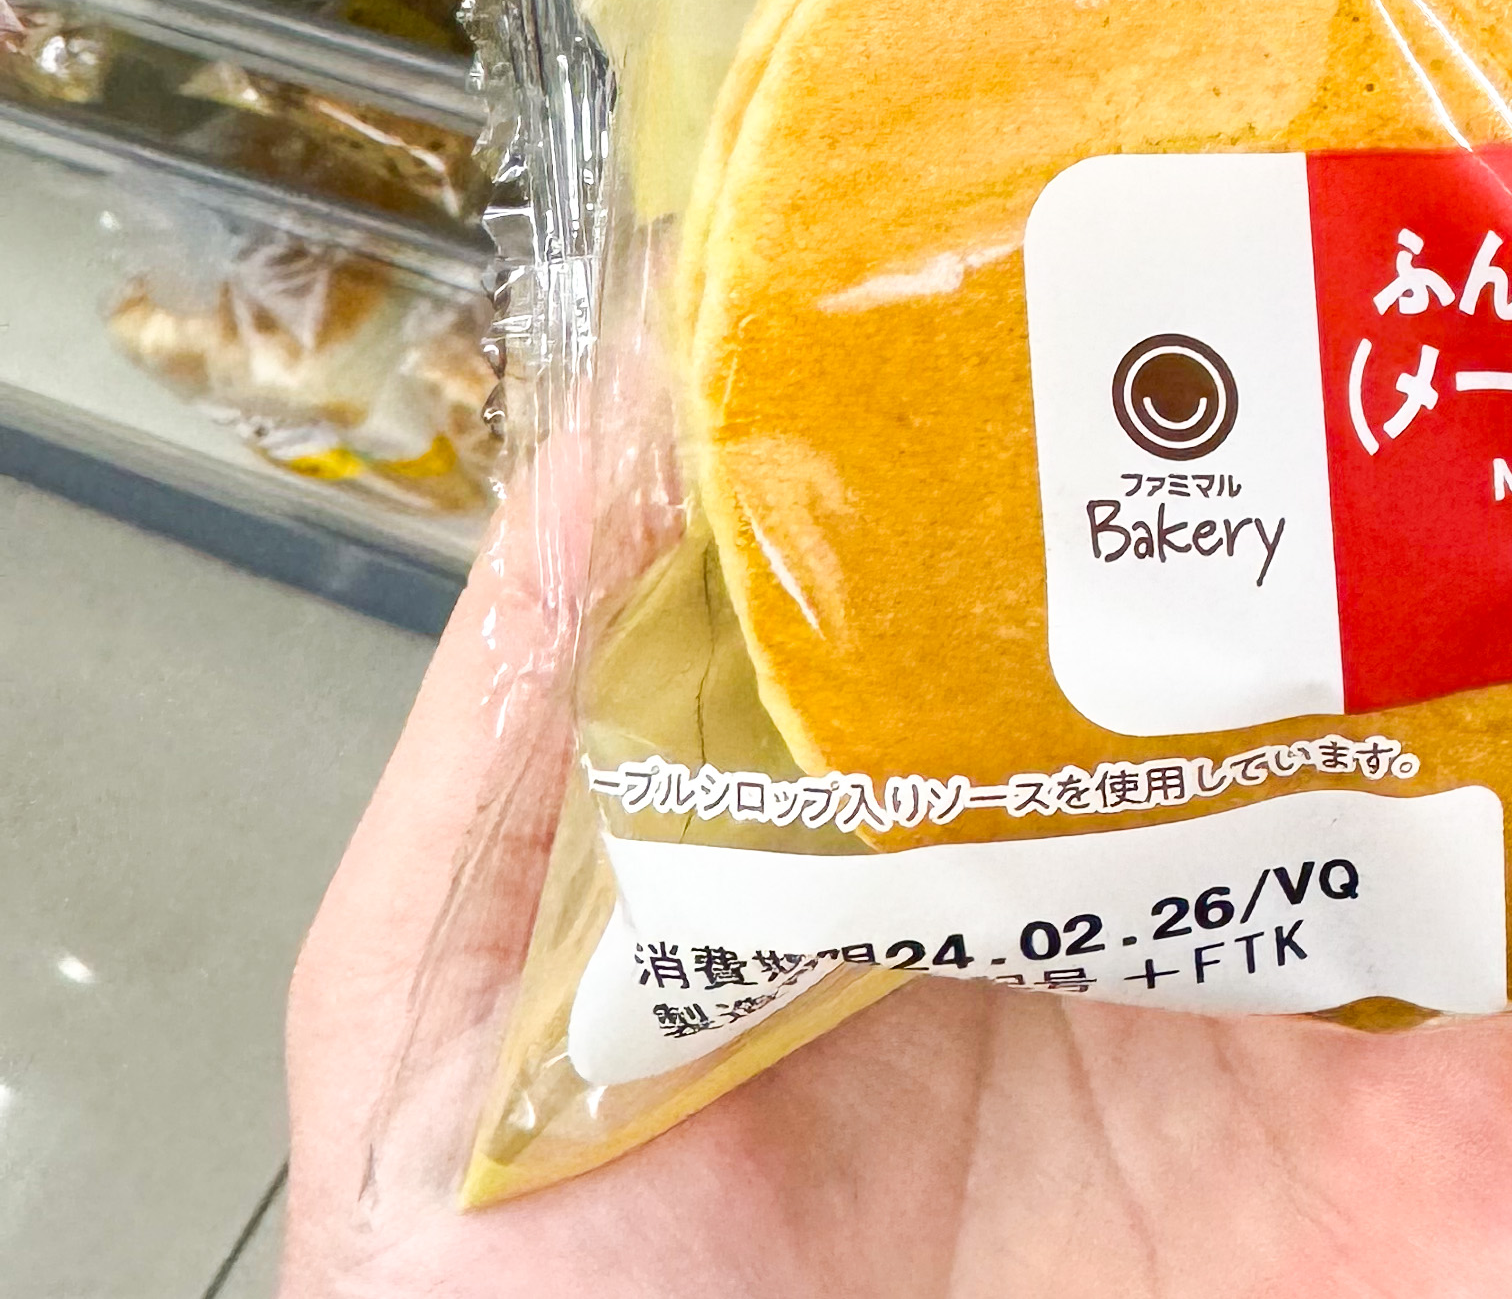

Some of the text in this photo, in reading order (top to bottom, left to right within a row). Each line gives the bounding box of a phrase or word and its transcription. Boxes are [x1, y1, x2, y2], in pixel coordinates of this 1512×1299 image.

[1120, 473, 1242, 499] ファミマル
[1086, 499, 1286, 587] Bakery
